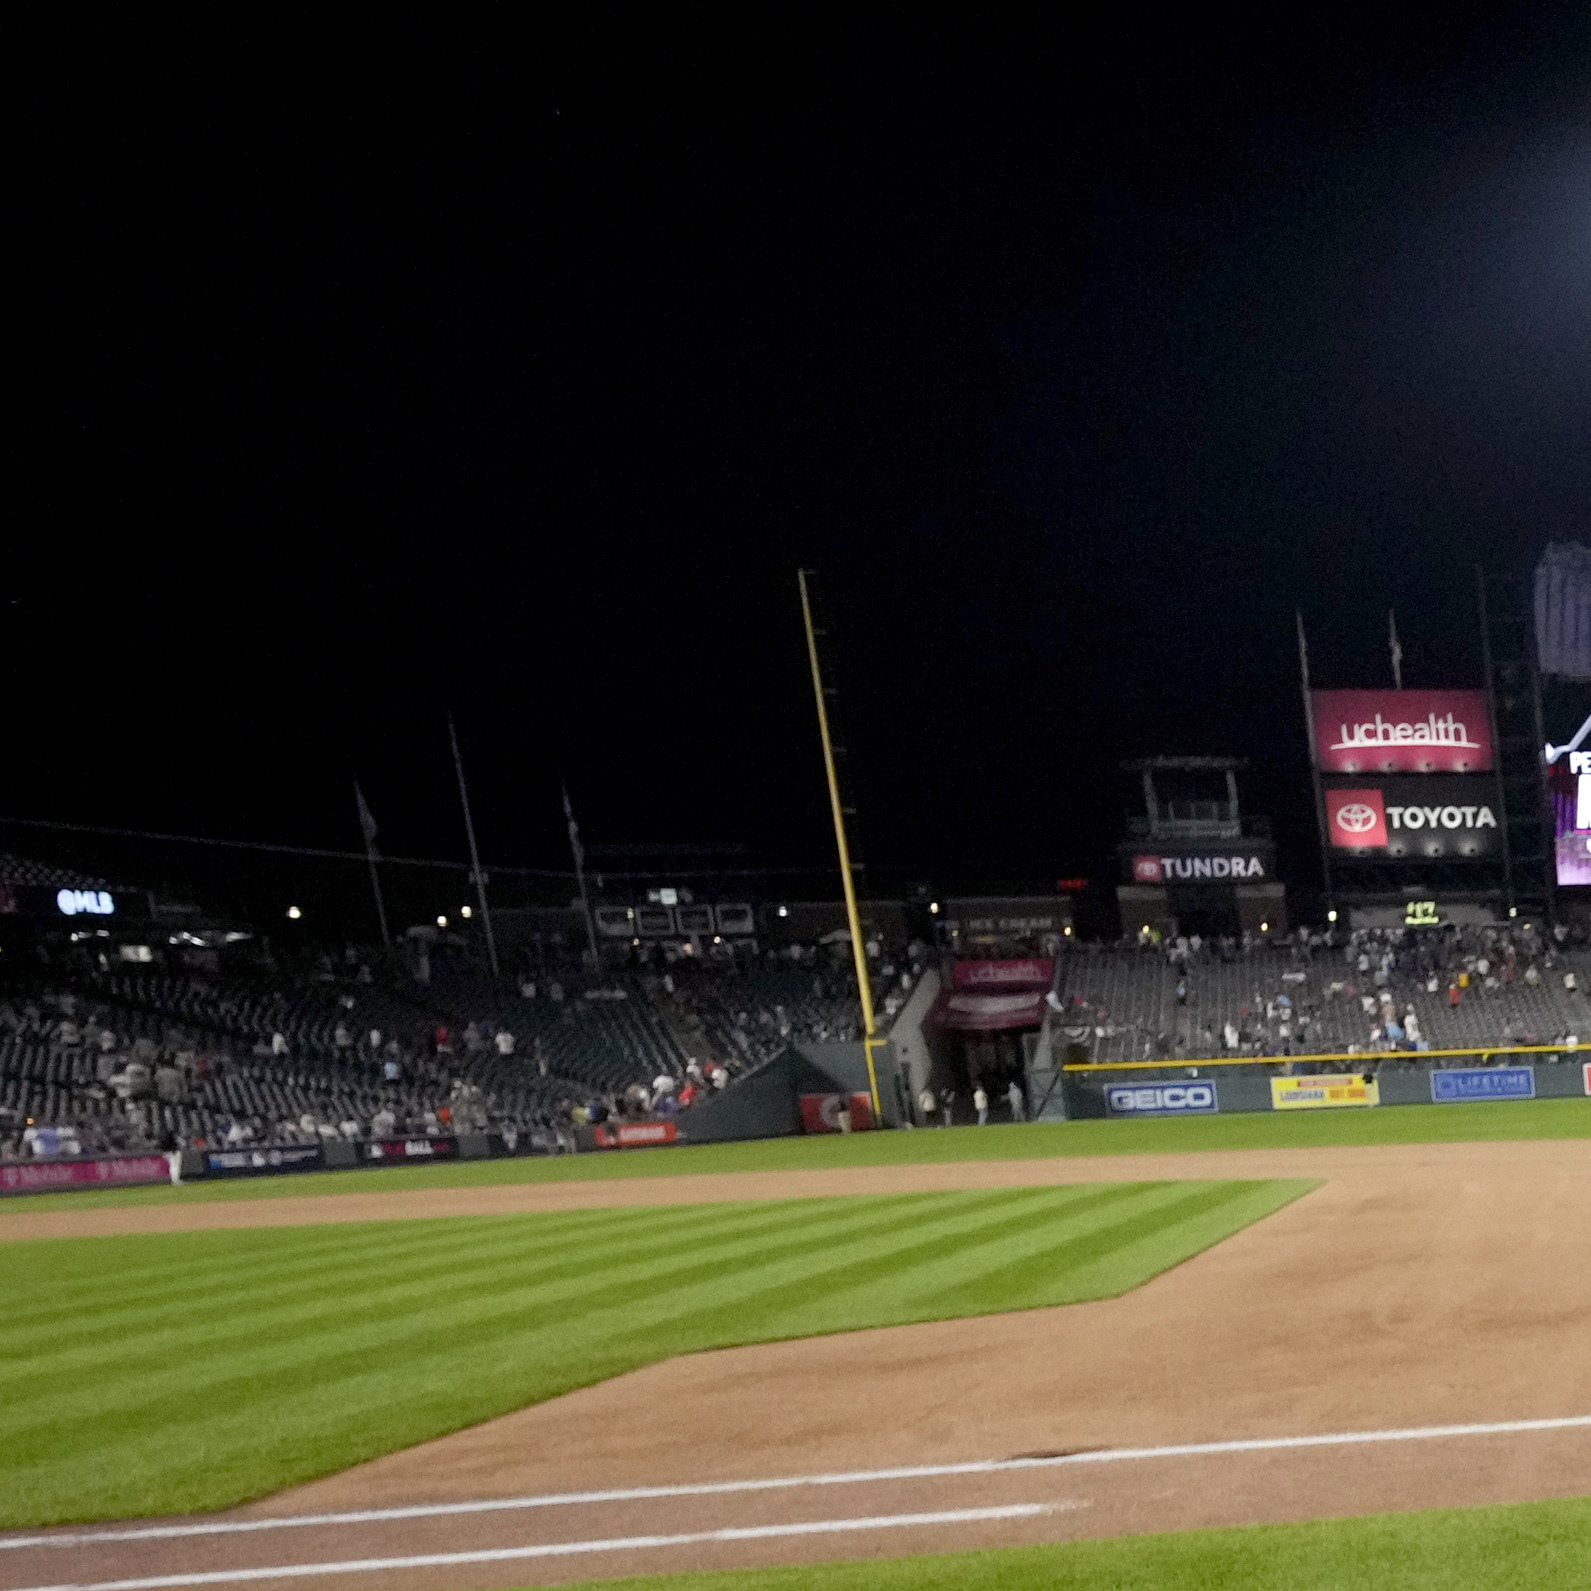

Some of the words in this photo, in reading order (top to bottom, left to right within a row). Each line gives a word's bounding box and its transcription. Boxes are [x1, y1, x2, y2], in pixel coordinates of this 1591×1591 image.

[1340, 712, 1469, 748] uchealth
[1385, 805, 1497, 830] TOYOTA
[1160, 856, 1266, 879] TUNDRA
[1109, 1086, 1212, 1110] GEICO
